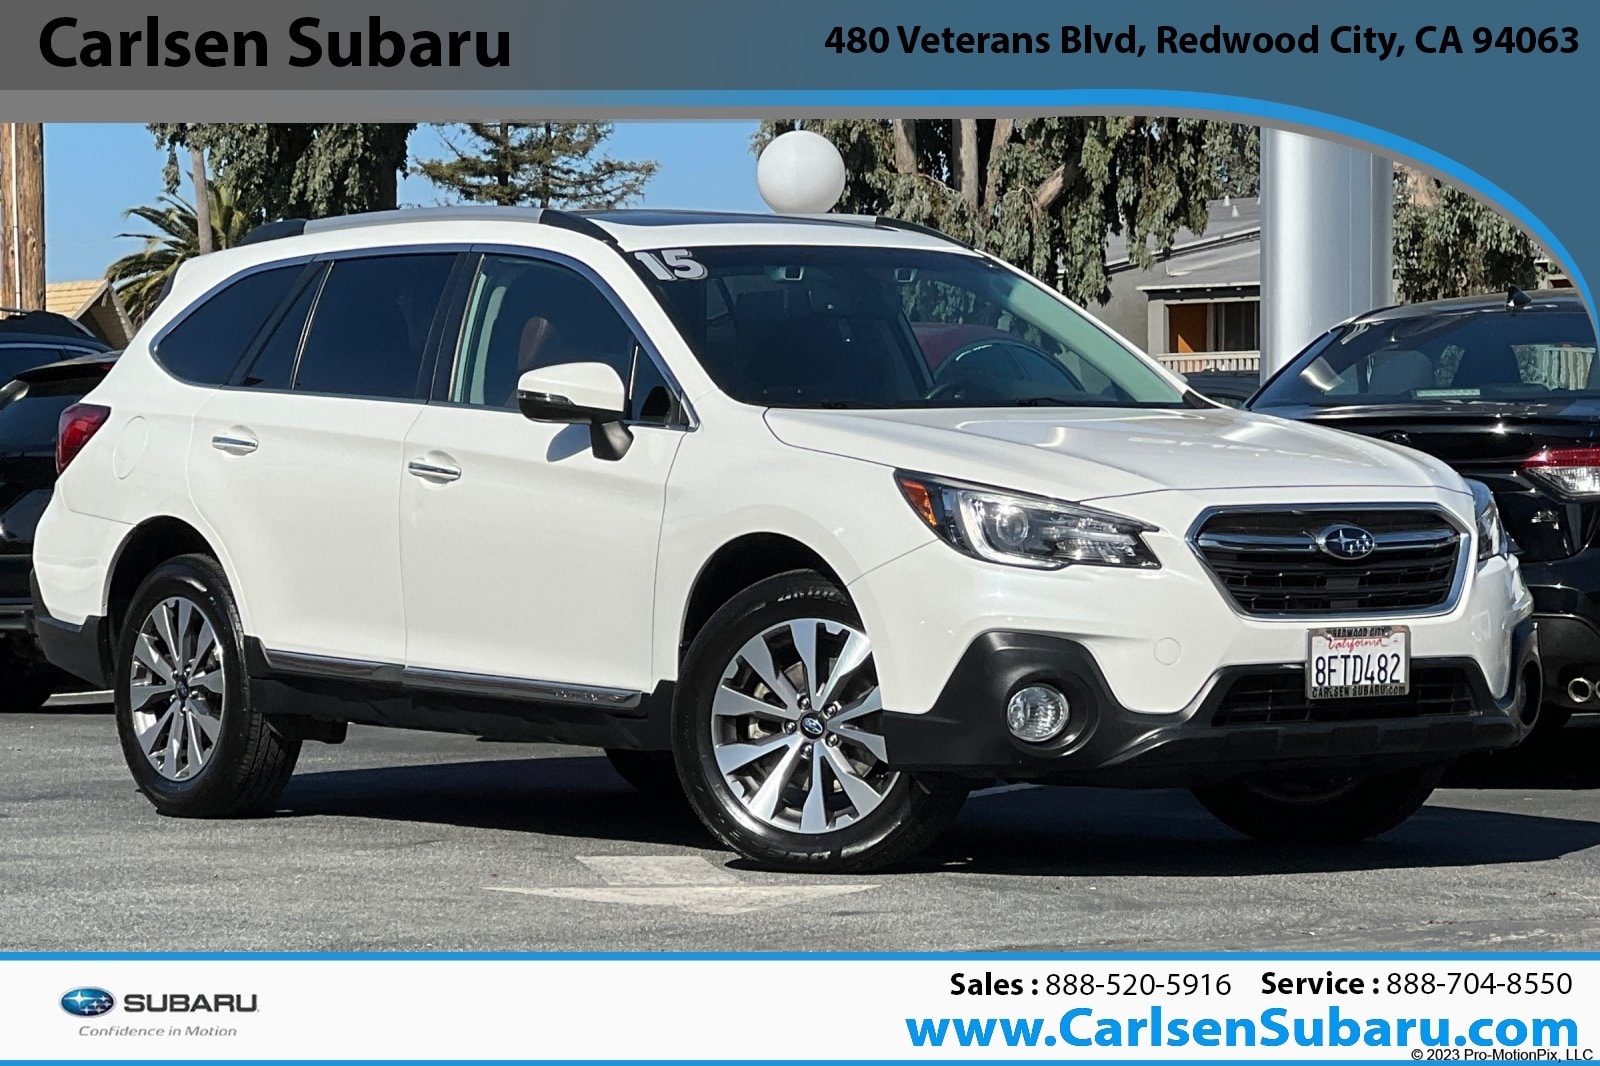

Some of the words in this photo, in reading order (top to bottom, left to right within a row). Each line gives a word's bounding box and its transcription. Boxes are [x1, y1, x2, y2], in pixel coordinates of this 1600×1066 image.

[634, 249, 708, 281] 15
[1332, 627, 1368, 638] REDWOOD
[1328, 637, 1389, 653] California
[1315, 653, 1400, 687] 8FTD482
[1312, 686, 1350, 698] CARLSEN
